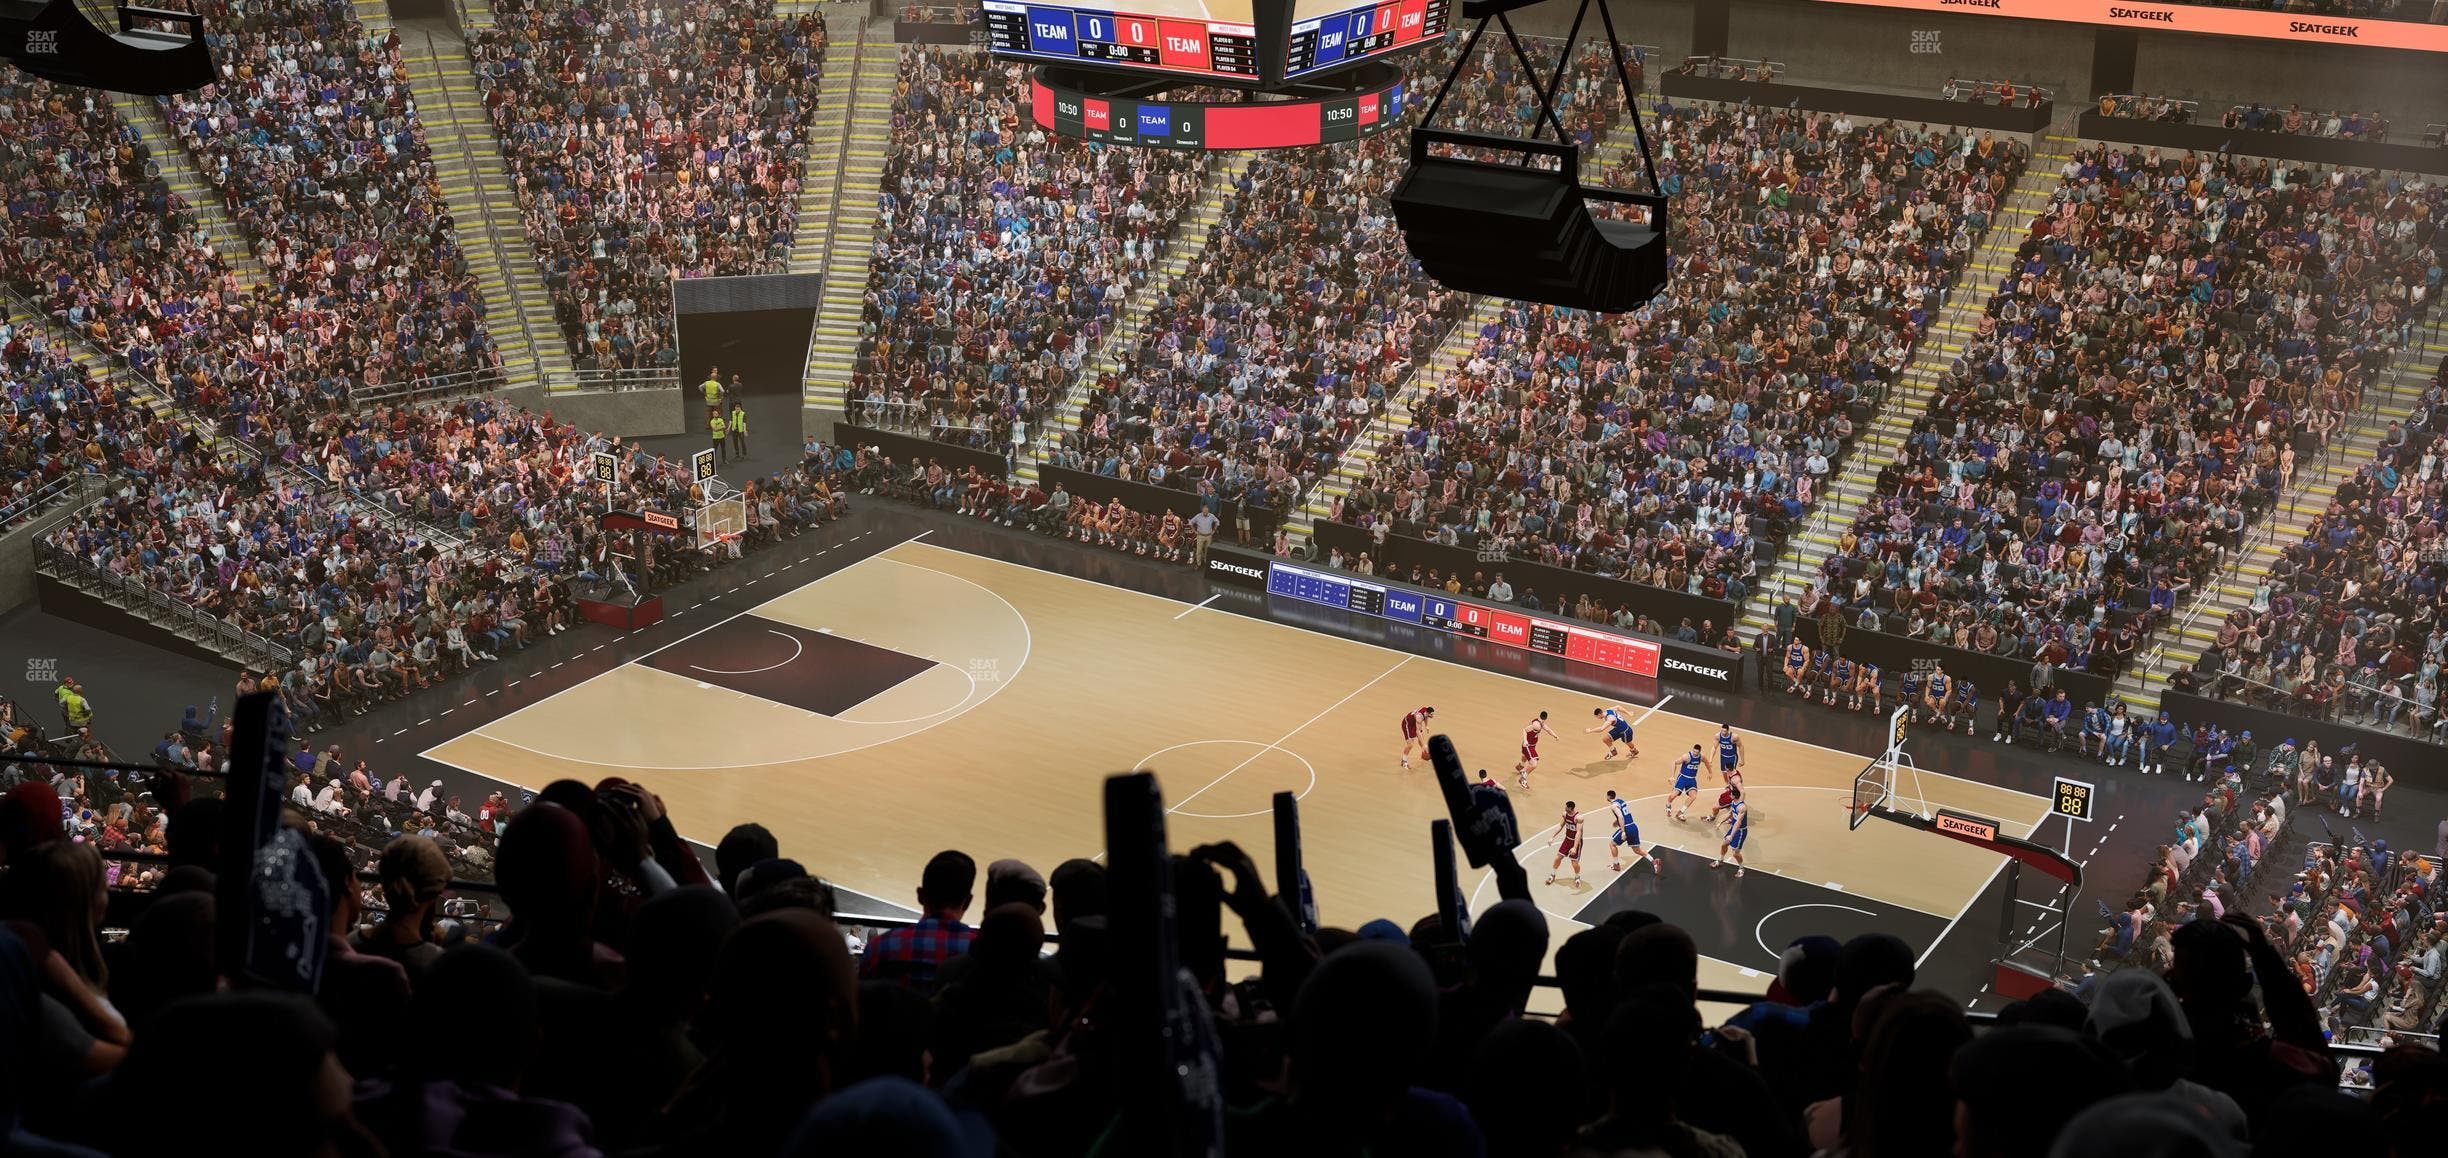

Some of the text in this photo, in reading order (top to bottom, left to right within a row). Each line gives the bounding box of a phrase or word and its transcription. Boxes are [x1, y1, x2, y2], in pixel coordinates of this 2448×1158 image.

[1382, 9, 1390, 29] 0
[1401, 11, 1421, 28] TEAM
[2110, 8, 2174, 22] SEATGEEK
[1034, 23, 1067, 40] TEAM
[1090, 19, 1102, 39] 0
[1131, 22, 1143, 43] 0
[1357, 16, 1366, 35] 0
[2290, 22, 2358, 37] SEATGEEK
[1166, 36, 1200, 54] TEAM
[1322, 31, 1342, 49] TEAM
[1109, 45, 1128, 56] 0:00
[1059, 102, 1077, 116] 10:50
[1087, 109, 1106, 120] TEAM
[1327, 108, 1352, 120] 10:50
[1361, 104, 1376, 114] TEAM
[1120, 118, 1126, 128] 0
[1141, 116, 1166, 125] TEAM
[1183, 122, 1190, 132] 0
[600, 466, 611, 479] 88
[701, 463, 711, 478] 88
[1210, 560, 1263, 580] SEATGEEK
[1390, 599, 1416, 612] TEAM
[1435, 603, 1444, 616] 0
[1468, 610, 1478, 623] 0
[1446, 620, 1462, 630] 0:00
[1496, 622, 1522, 636] TEAM
[1664, 658, 1728, 681] SEATGEEK
[2060, 784, 2086, 798] 88 88
[2062, 796, 2082, 815] 88
[480, 810, 489, 820] 00
[1943, 818, 1987, 837] SEATGEEK
